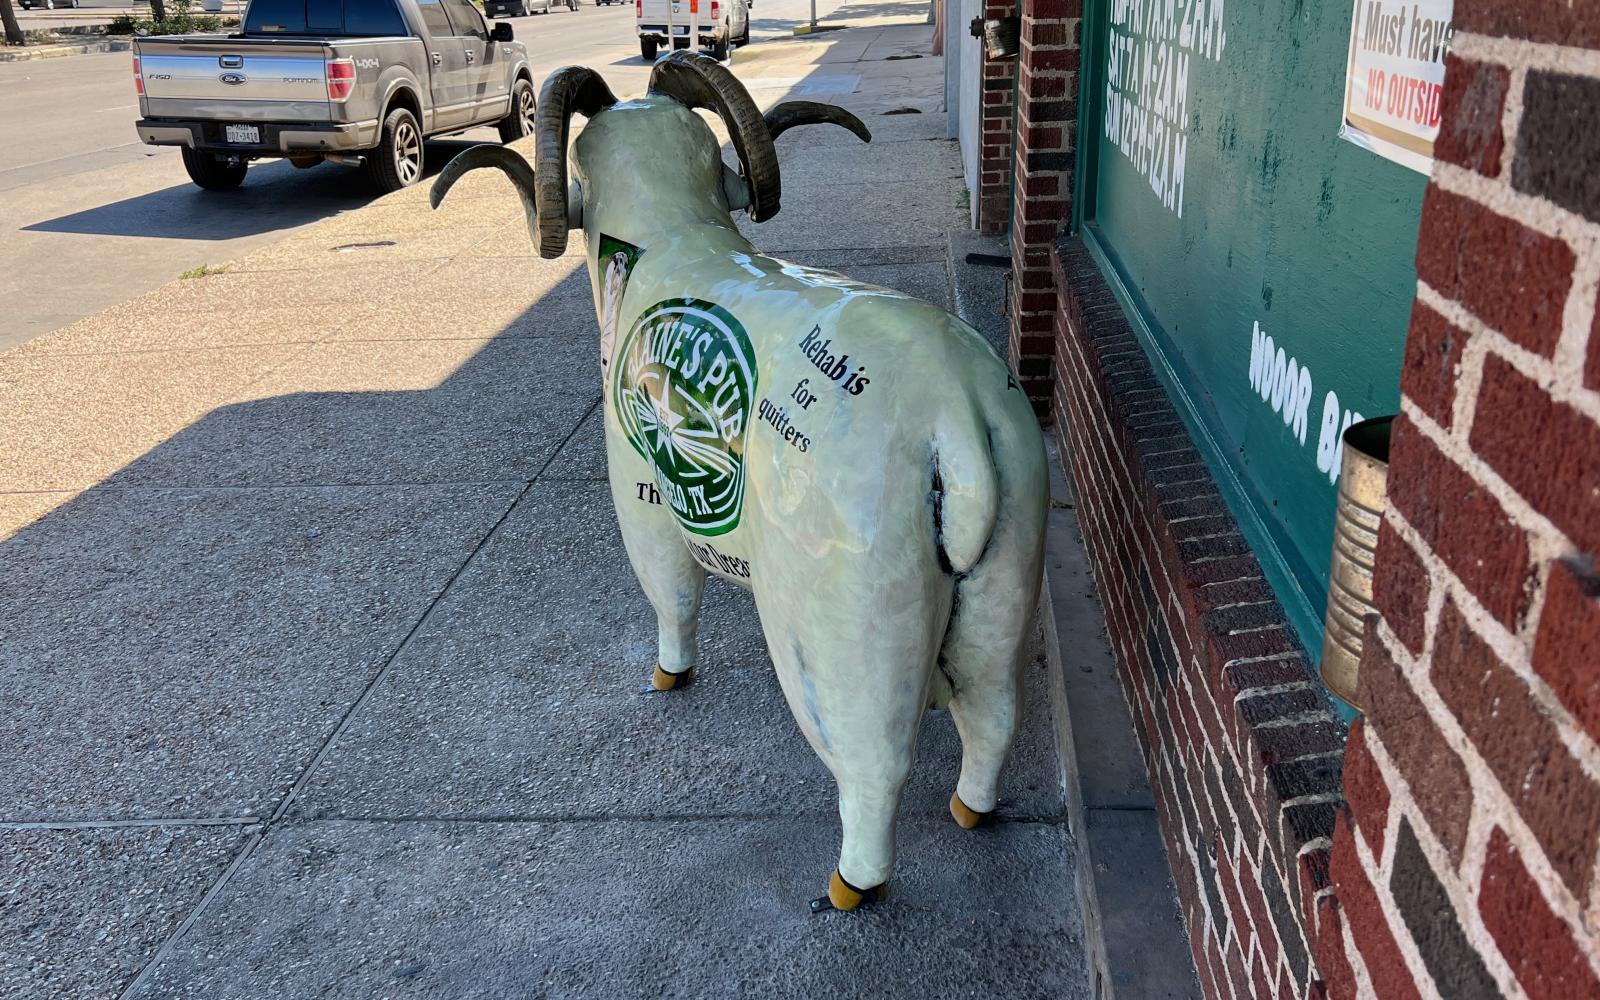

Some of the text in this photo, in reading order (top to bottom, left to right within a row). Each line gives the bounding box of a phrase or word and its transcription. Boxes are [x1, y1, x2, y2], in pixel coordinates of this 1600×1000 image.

[1364, 1, 1406, 57] Must
[1365, 68, 1386, 113] NO
[798, 323, 870, 396] Rehab is
[697, 350, 743, 444] PUB
[790, 378, 817, 411] for
[758, 398, 811, 453] quitters
[687, 484, 713, 516] TX
